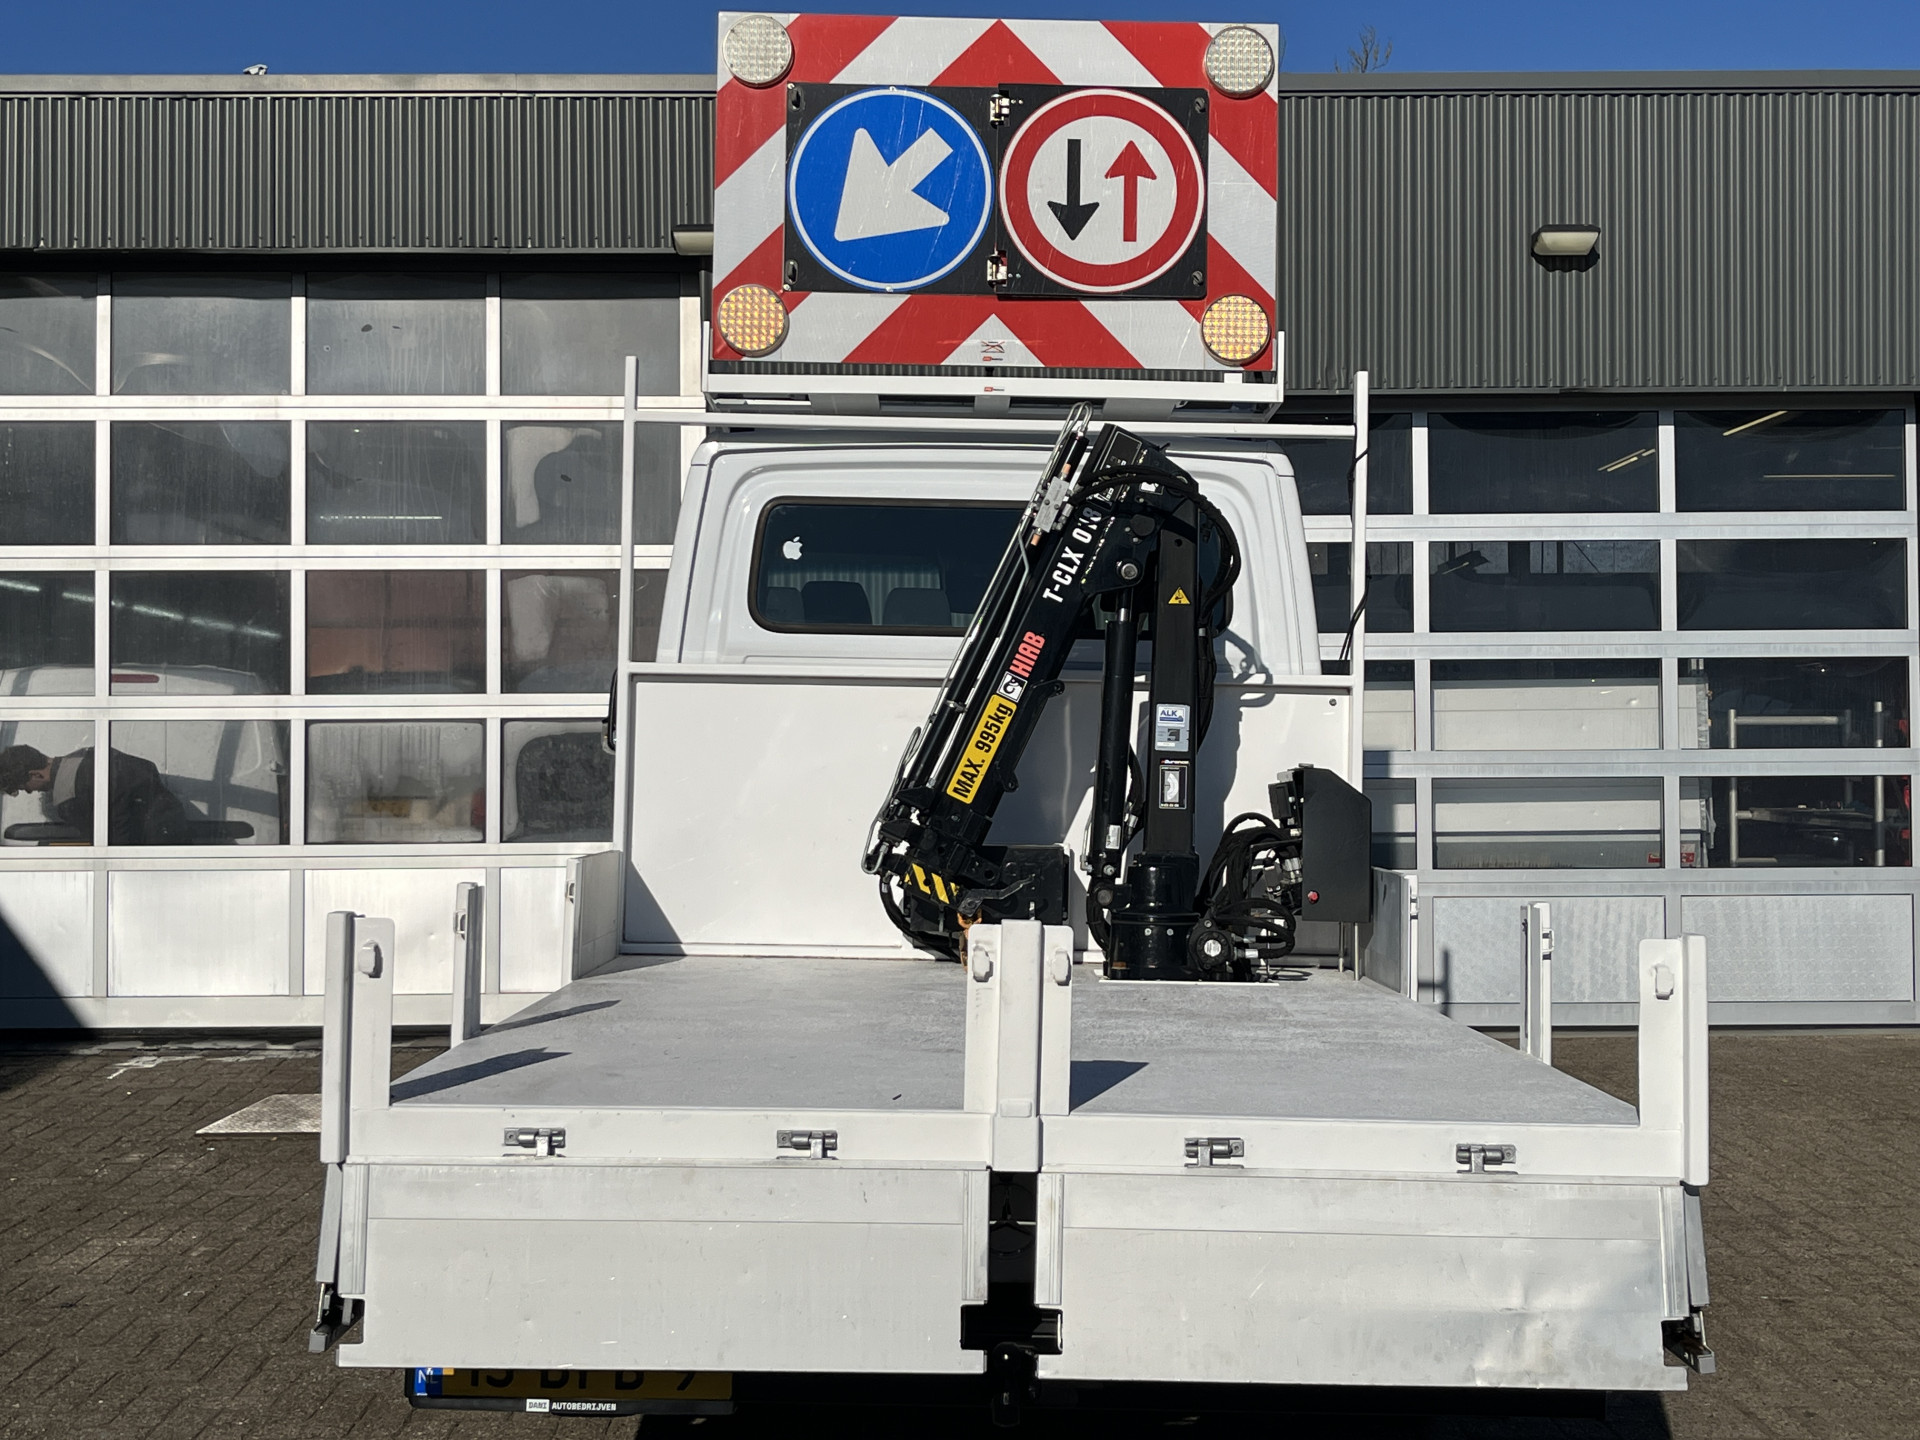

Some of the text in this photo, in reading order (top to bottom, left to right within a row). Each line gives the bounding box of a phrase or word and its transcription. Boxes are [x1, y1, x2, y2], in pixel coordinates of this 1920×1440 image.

[1042, 546, 1085, 603] T-CLX
[1009, 631, 1046, 678] HIAB
[1160, 709, 1177, 717] ALK
[952, 702, 1014, 798] MAX. 995kg
[551, 1402, 617, 1411] AUTOBEDRIJVEN
